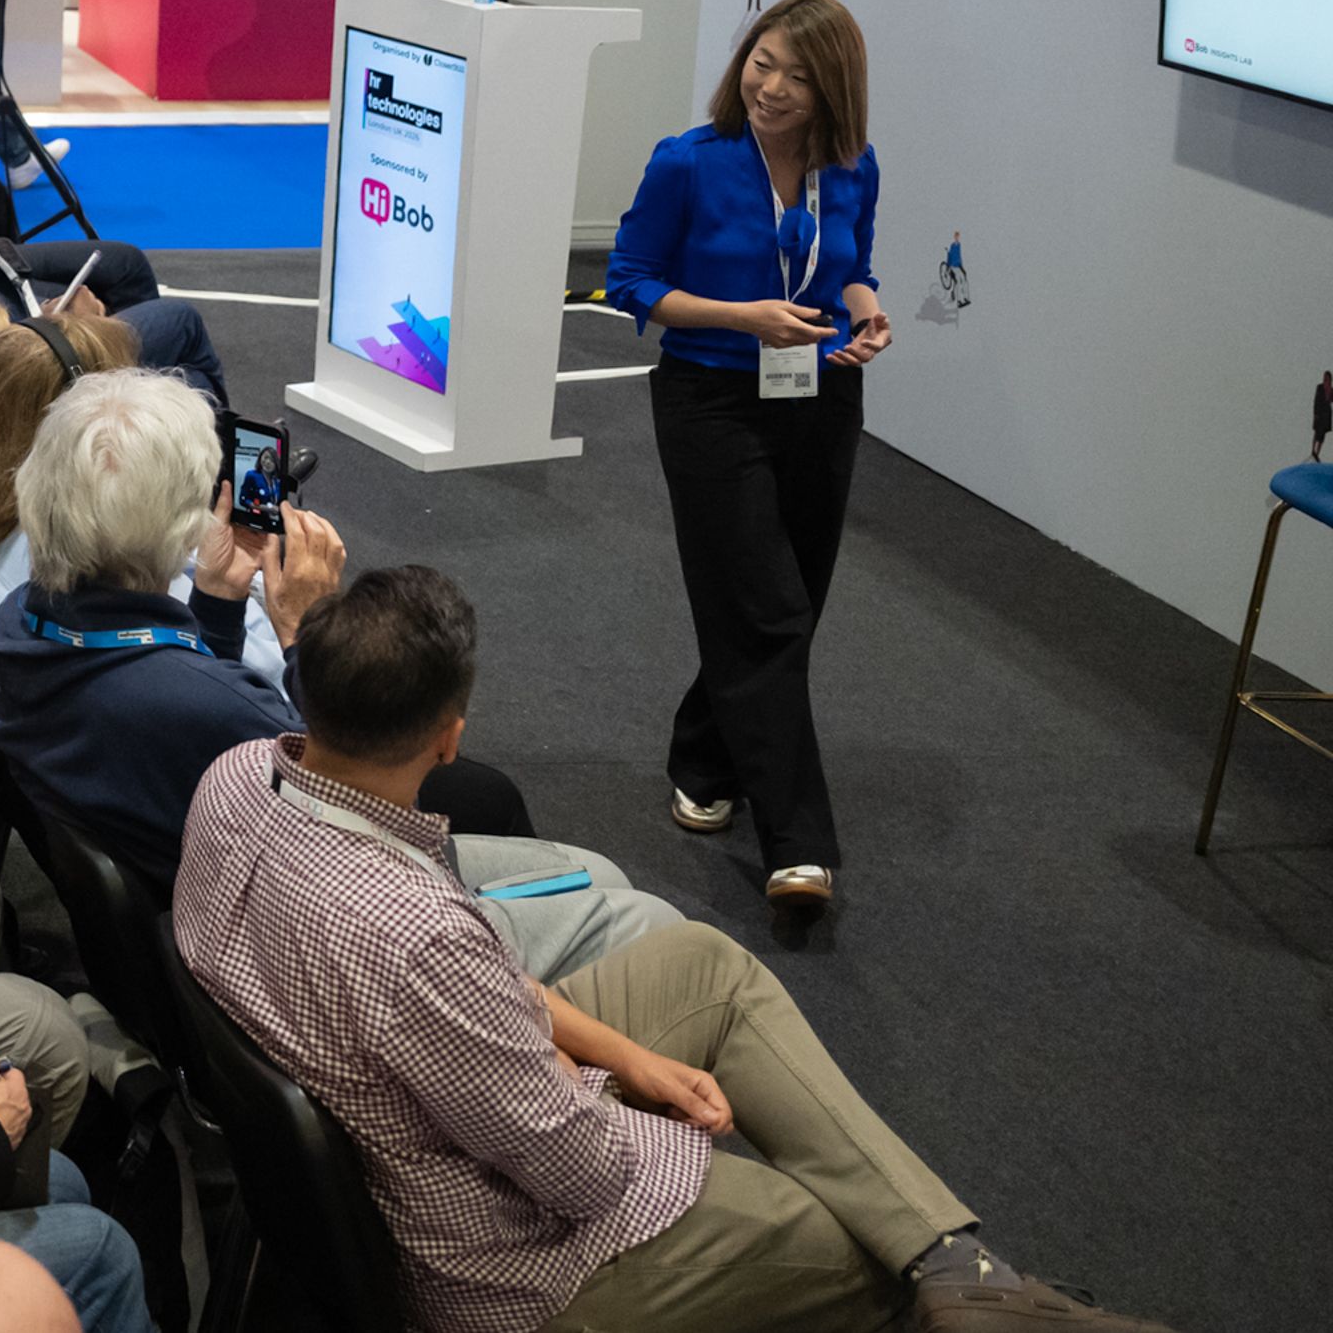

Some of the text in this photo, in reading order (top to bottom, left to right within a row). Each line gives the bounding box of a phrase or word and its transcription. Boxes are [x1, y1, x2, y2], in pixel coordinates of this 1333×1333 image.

[372, 41, 411, 60] Organised
[412, 52, 422, 63] by
[369, 71, 383, 89] hr
[367, 92, 441, 129] technologies
[370, 152, 429, 183] Sponsored by
[361, 179, 434, 233] HiBob
